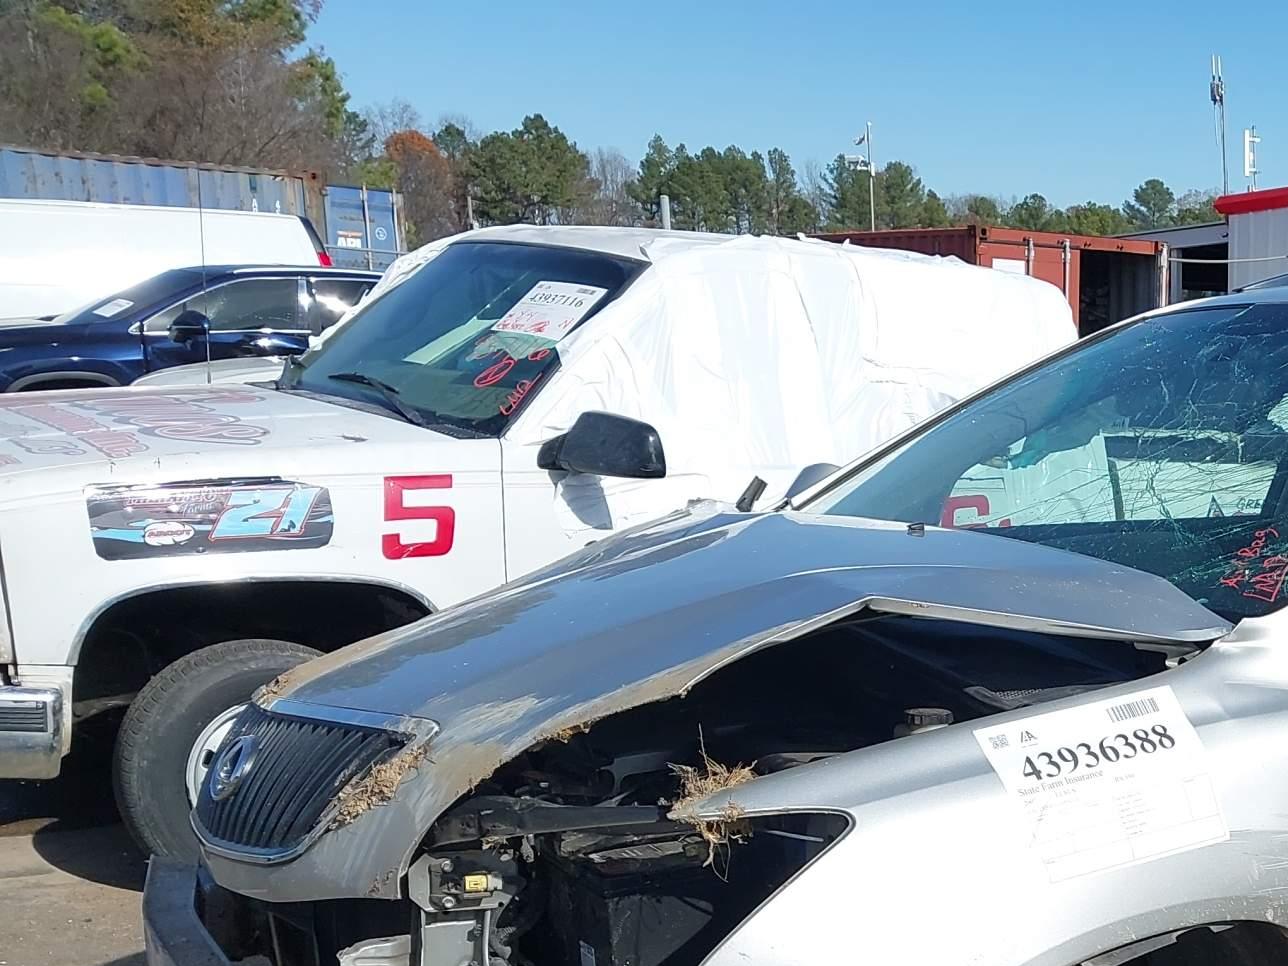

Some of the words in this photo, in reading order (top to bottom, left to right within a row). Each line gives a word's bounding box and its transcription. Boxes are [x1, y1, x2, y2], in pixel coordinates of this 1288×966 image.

[208, 487, 322, 543] 21
[382, 473, 456, 560] 5
[1022, 723, 1176, 781] 43936388
[1017, 785, 1040, 798] State
[1041, 780, 1065, 792] Farm
[1064, 769, 1104, 786] Insurance
